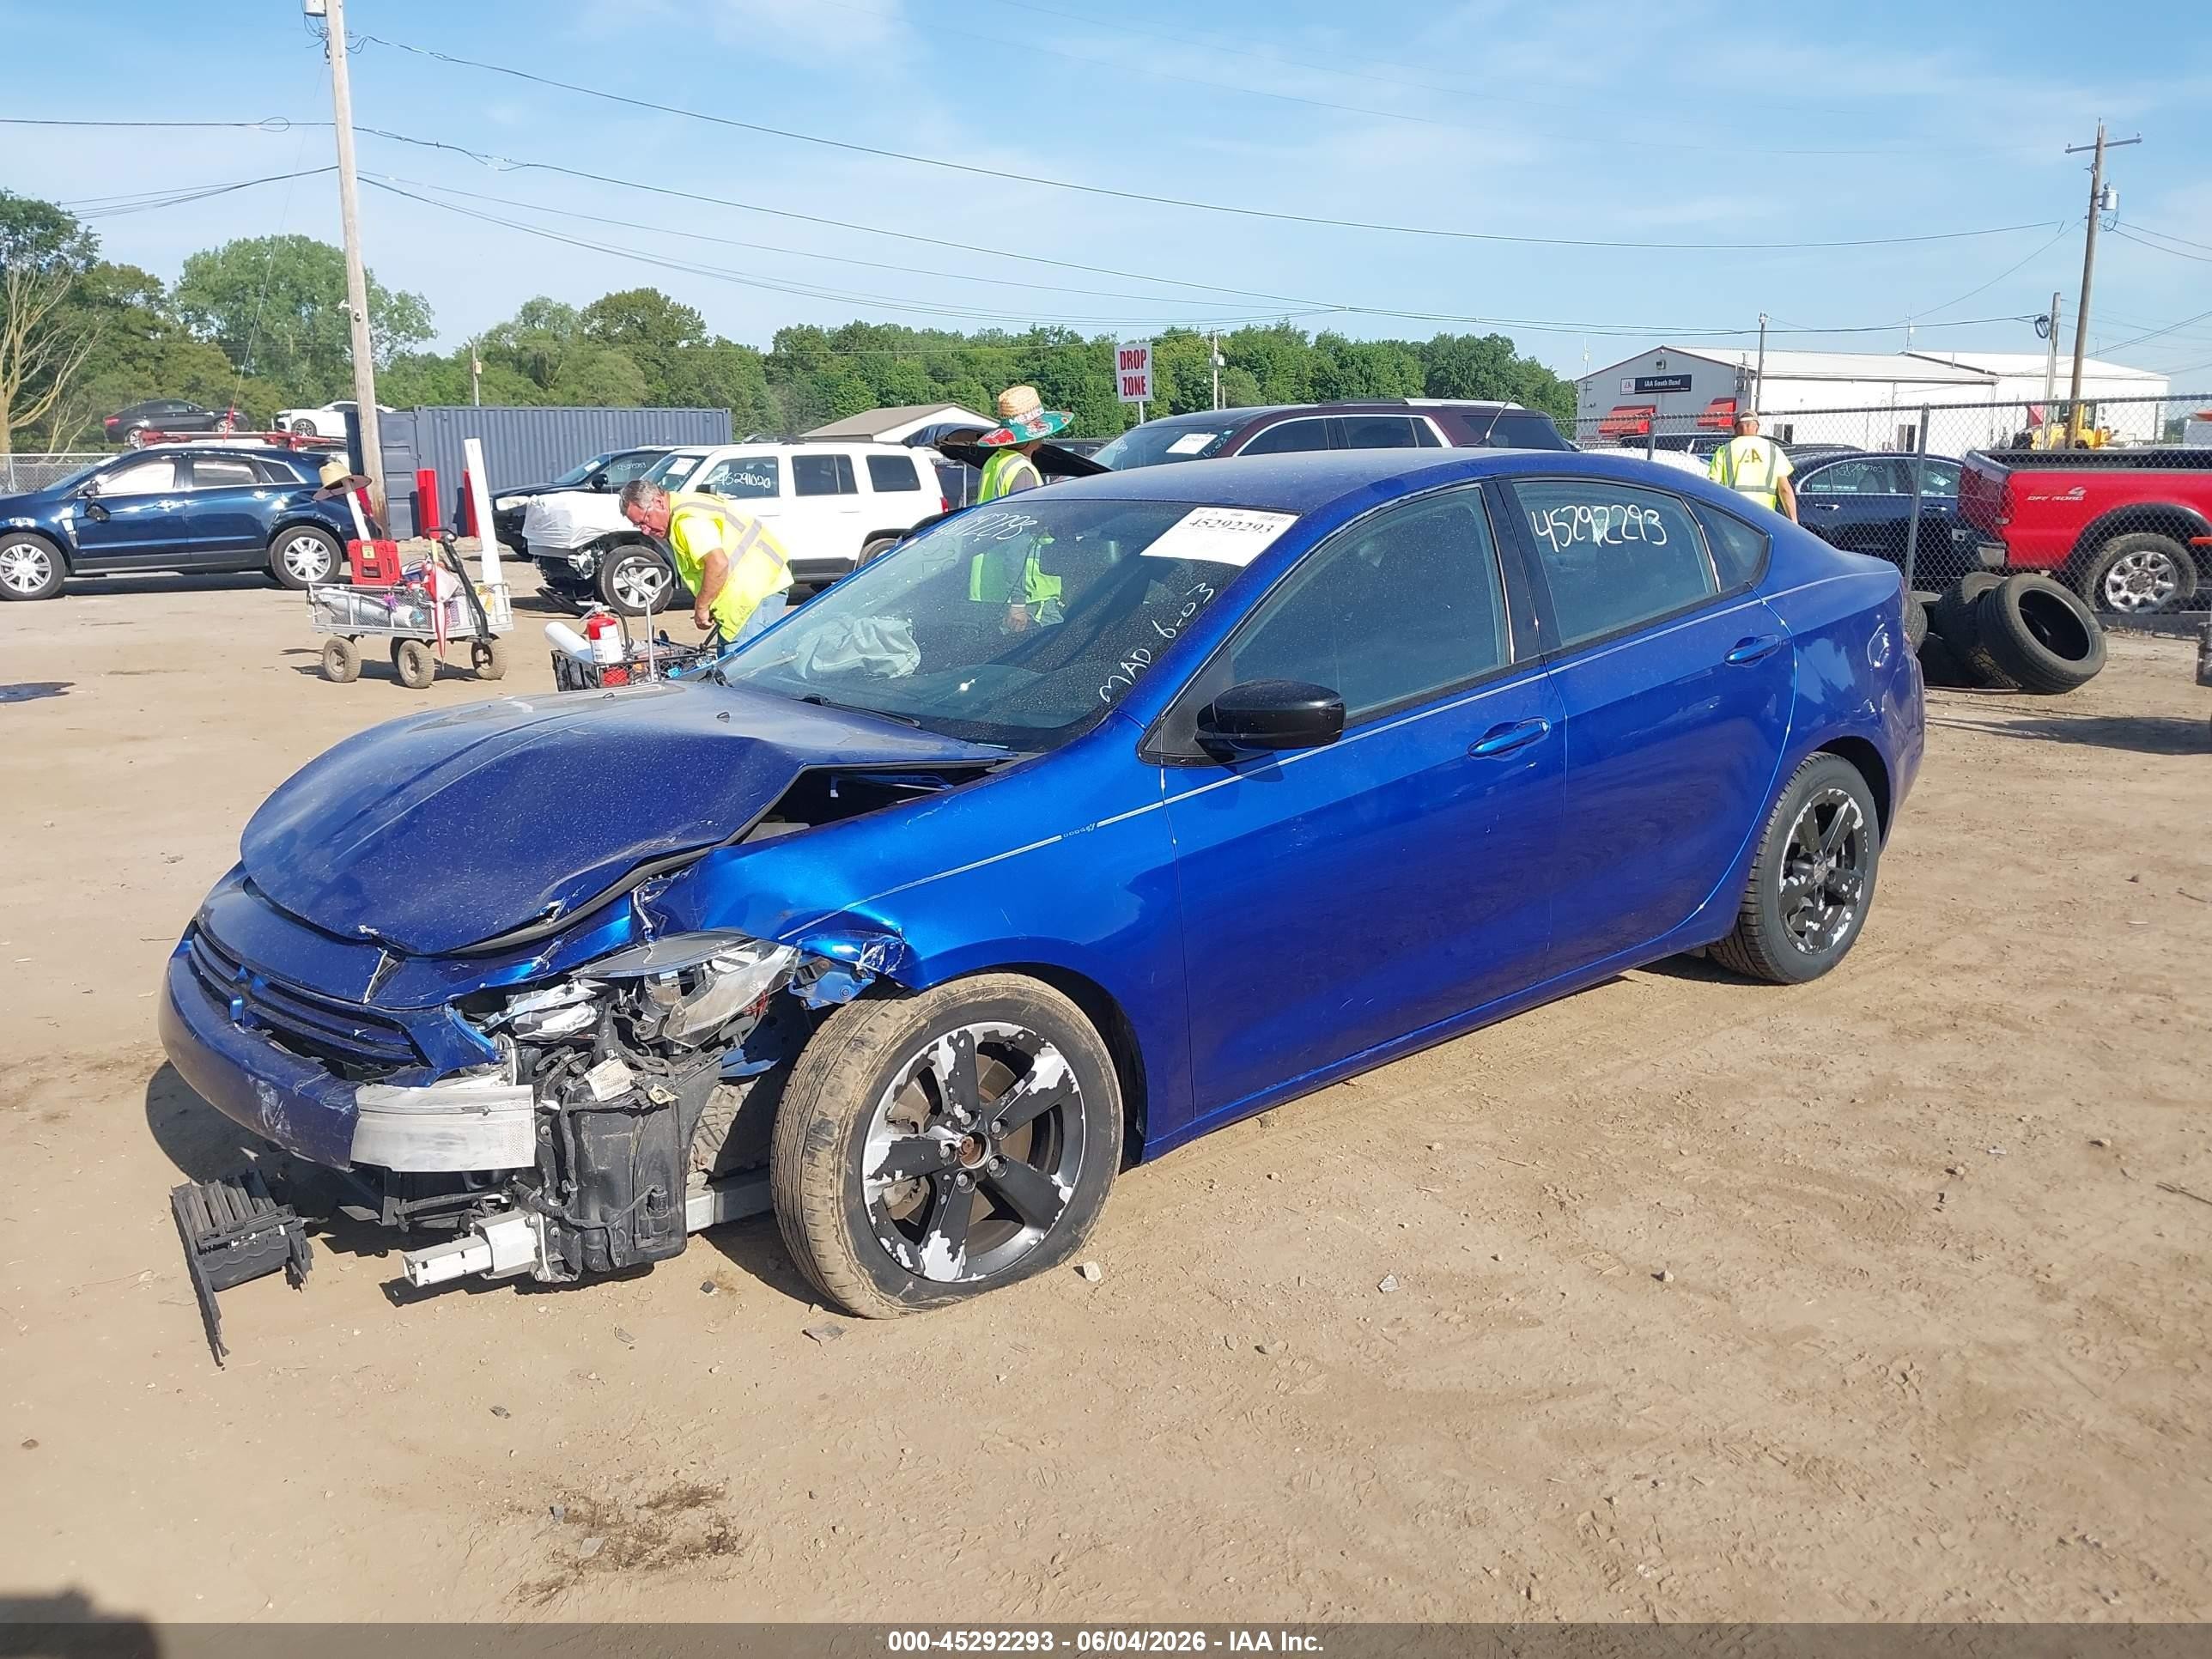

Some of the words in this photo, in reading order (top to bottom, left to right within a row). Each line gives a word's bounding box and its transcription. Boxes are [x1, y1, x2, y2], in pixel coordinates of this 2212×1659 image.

[1120, 349, 1146, 370] DROP
[1122, 376, 1146, 396] ZONE
[1189, 518, 1275, 534] 45292293
[1531, 504, 1668, 553] 45292293
[1099, 648, 1152, 703] MAD
[1152, 582, 1214, 639] 6-03
